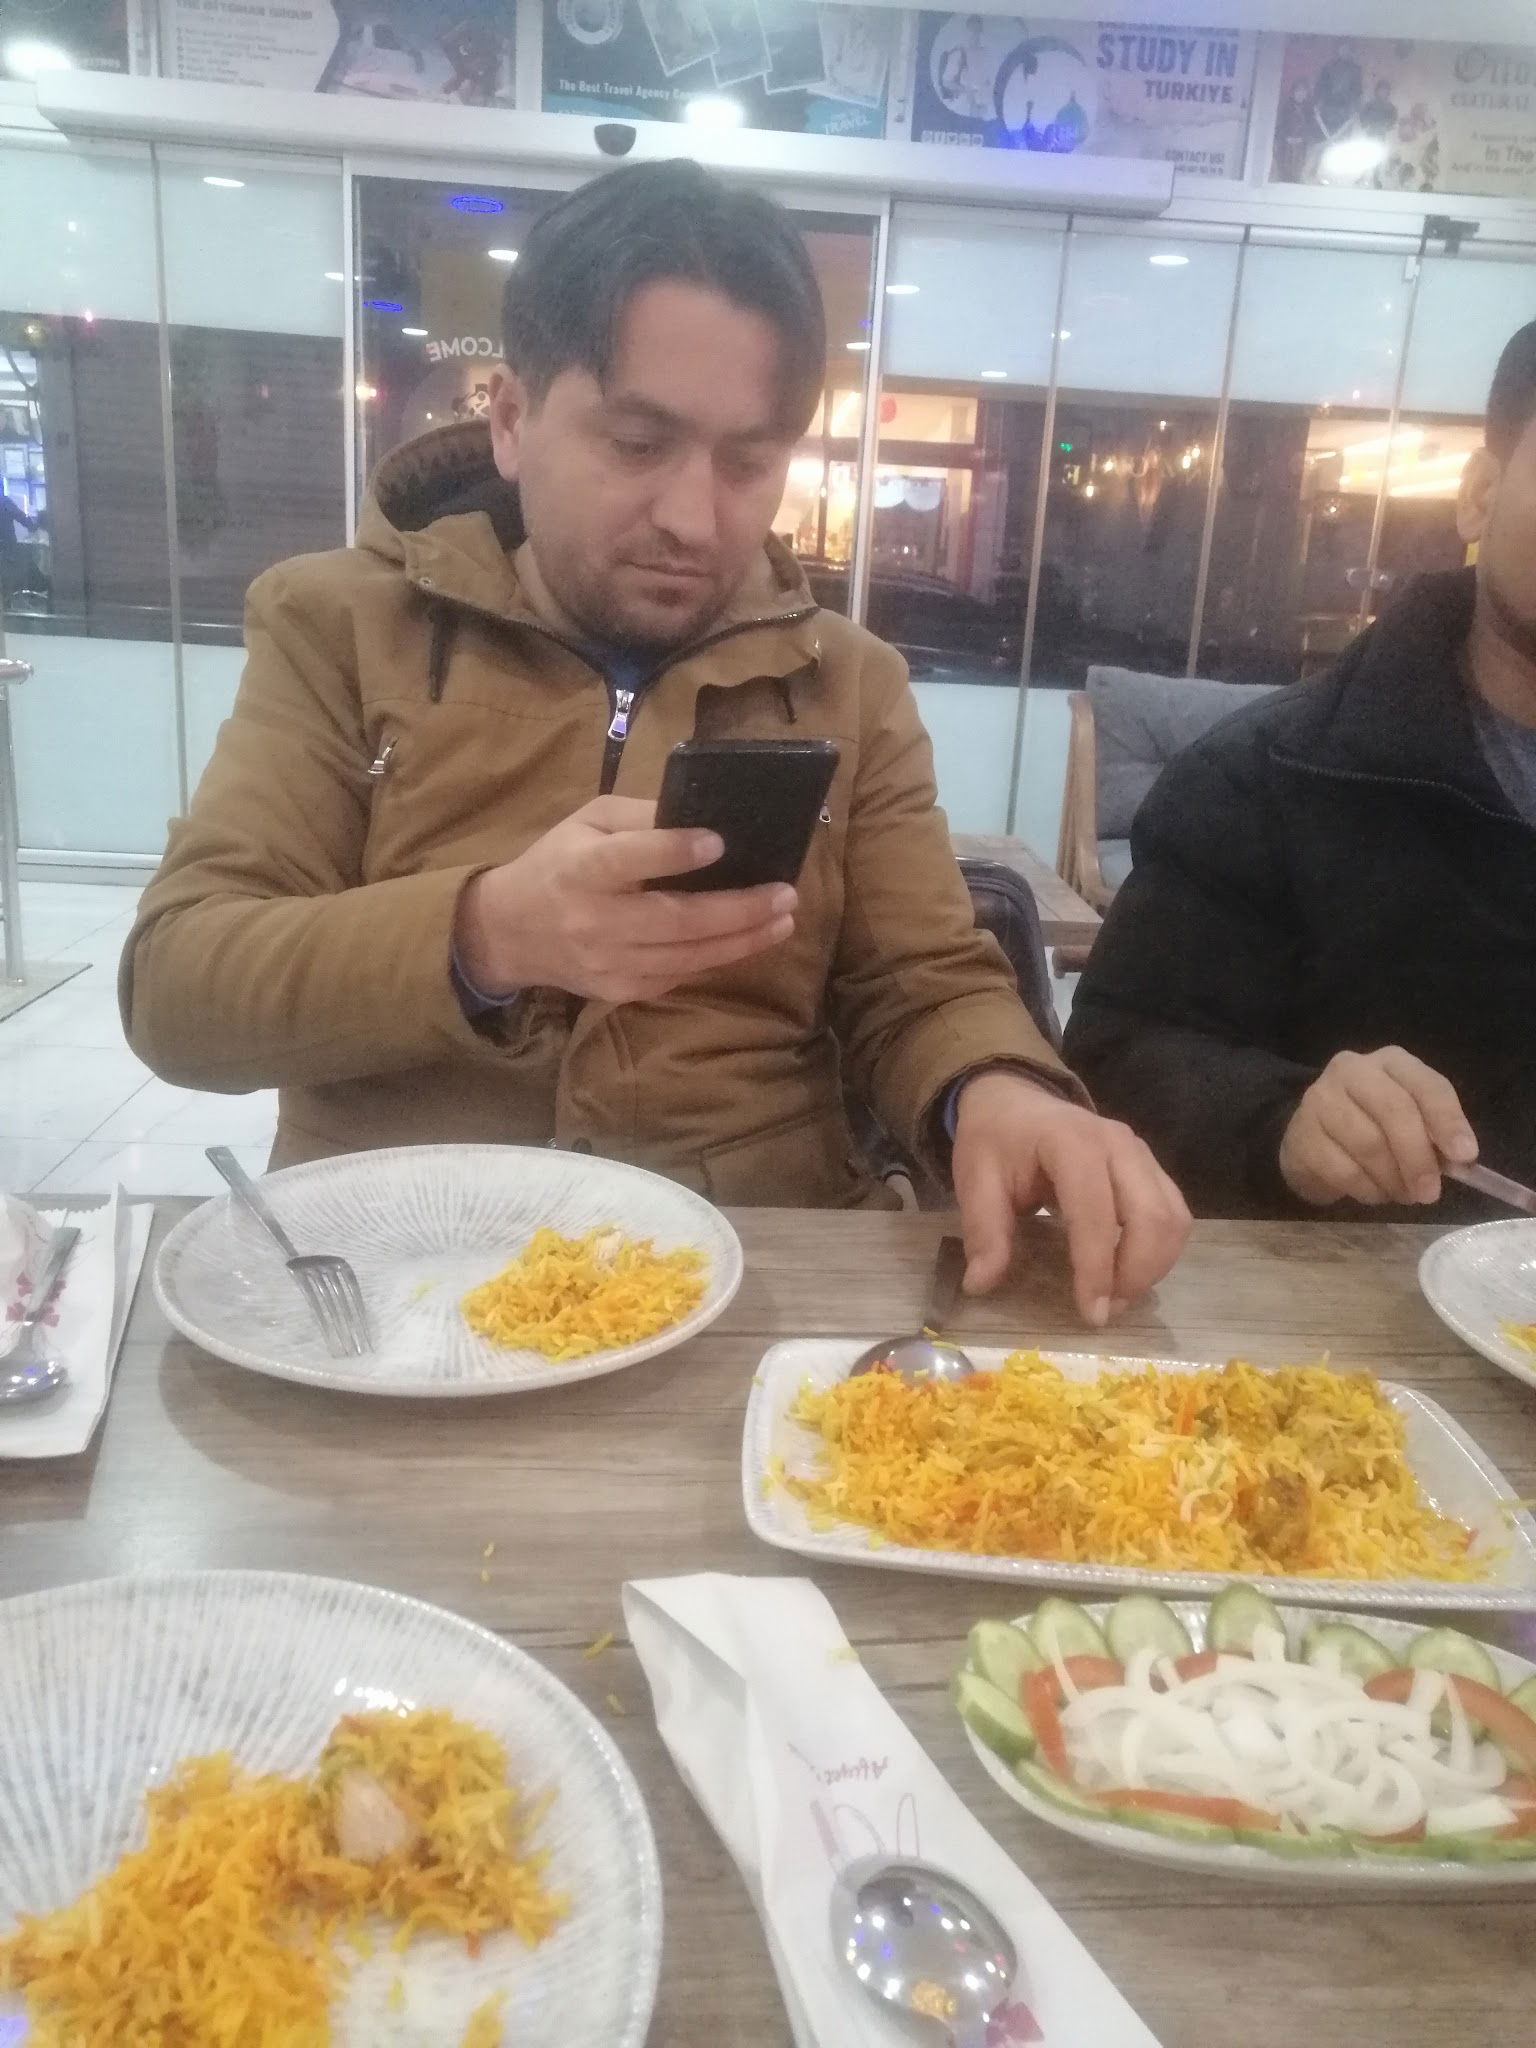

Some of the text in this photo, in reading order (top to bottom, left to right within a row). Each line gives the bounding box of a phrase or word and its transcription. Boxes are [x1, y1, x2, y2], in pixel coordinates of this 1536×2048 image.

[1096, 33, 1238, 78] STUDY IN
[559, 79, 576, 92] The
[578, 80, 601, 93] Best
[604, 82, 633, 96] Travel
[635, 85, 670, 100] Agency
